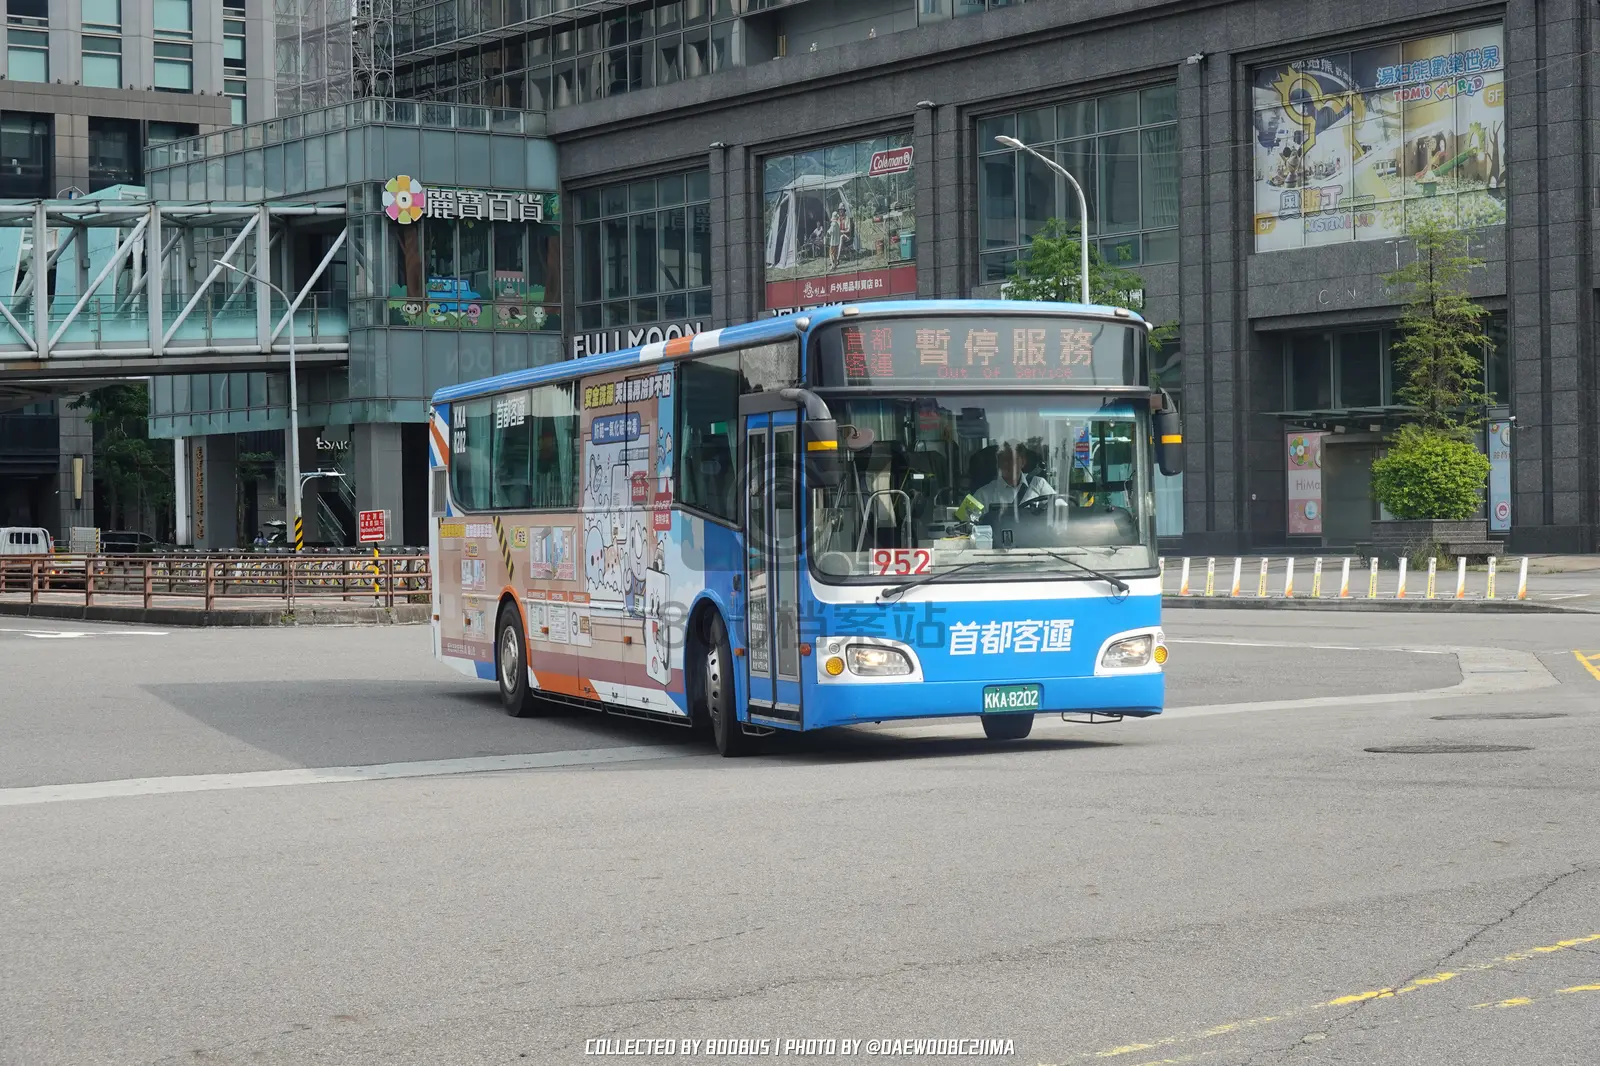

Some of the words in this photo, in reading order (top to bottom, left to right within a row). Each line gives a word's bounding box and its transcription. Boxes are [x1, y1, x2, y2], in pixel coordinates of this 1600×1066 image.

[1393, 83, 1433, 103] TOM'S
[1434, 75, 1485, 100] WORLD
[873, 154, 903, 170] Coleman
[425, 188, 544, 224] 麗寶百貨
[874, 279, 883, 288] B1
[844, 328, 893, 351] 首都
[915, 328, 1094, 366] 暫停服務
[937, 367, 967, 379] Out
[874, 549, 931, 576] 952
[949, 619, 1075, 656] 首都客運
